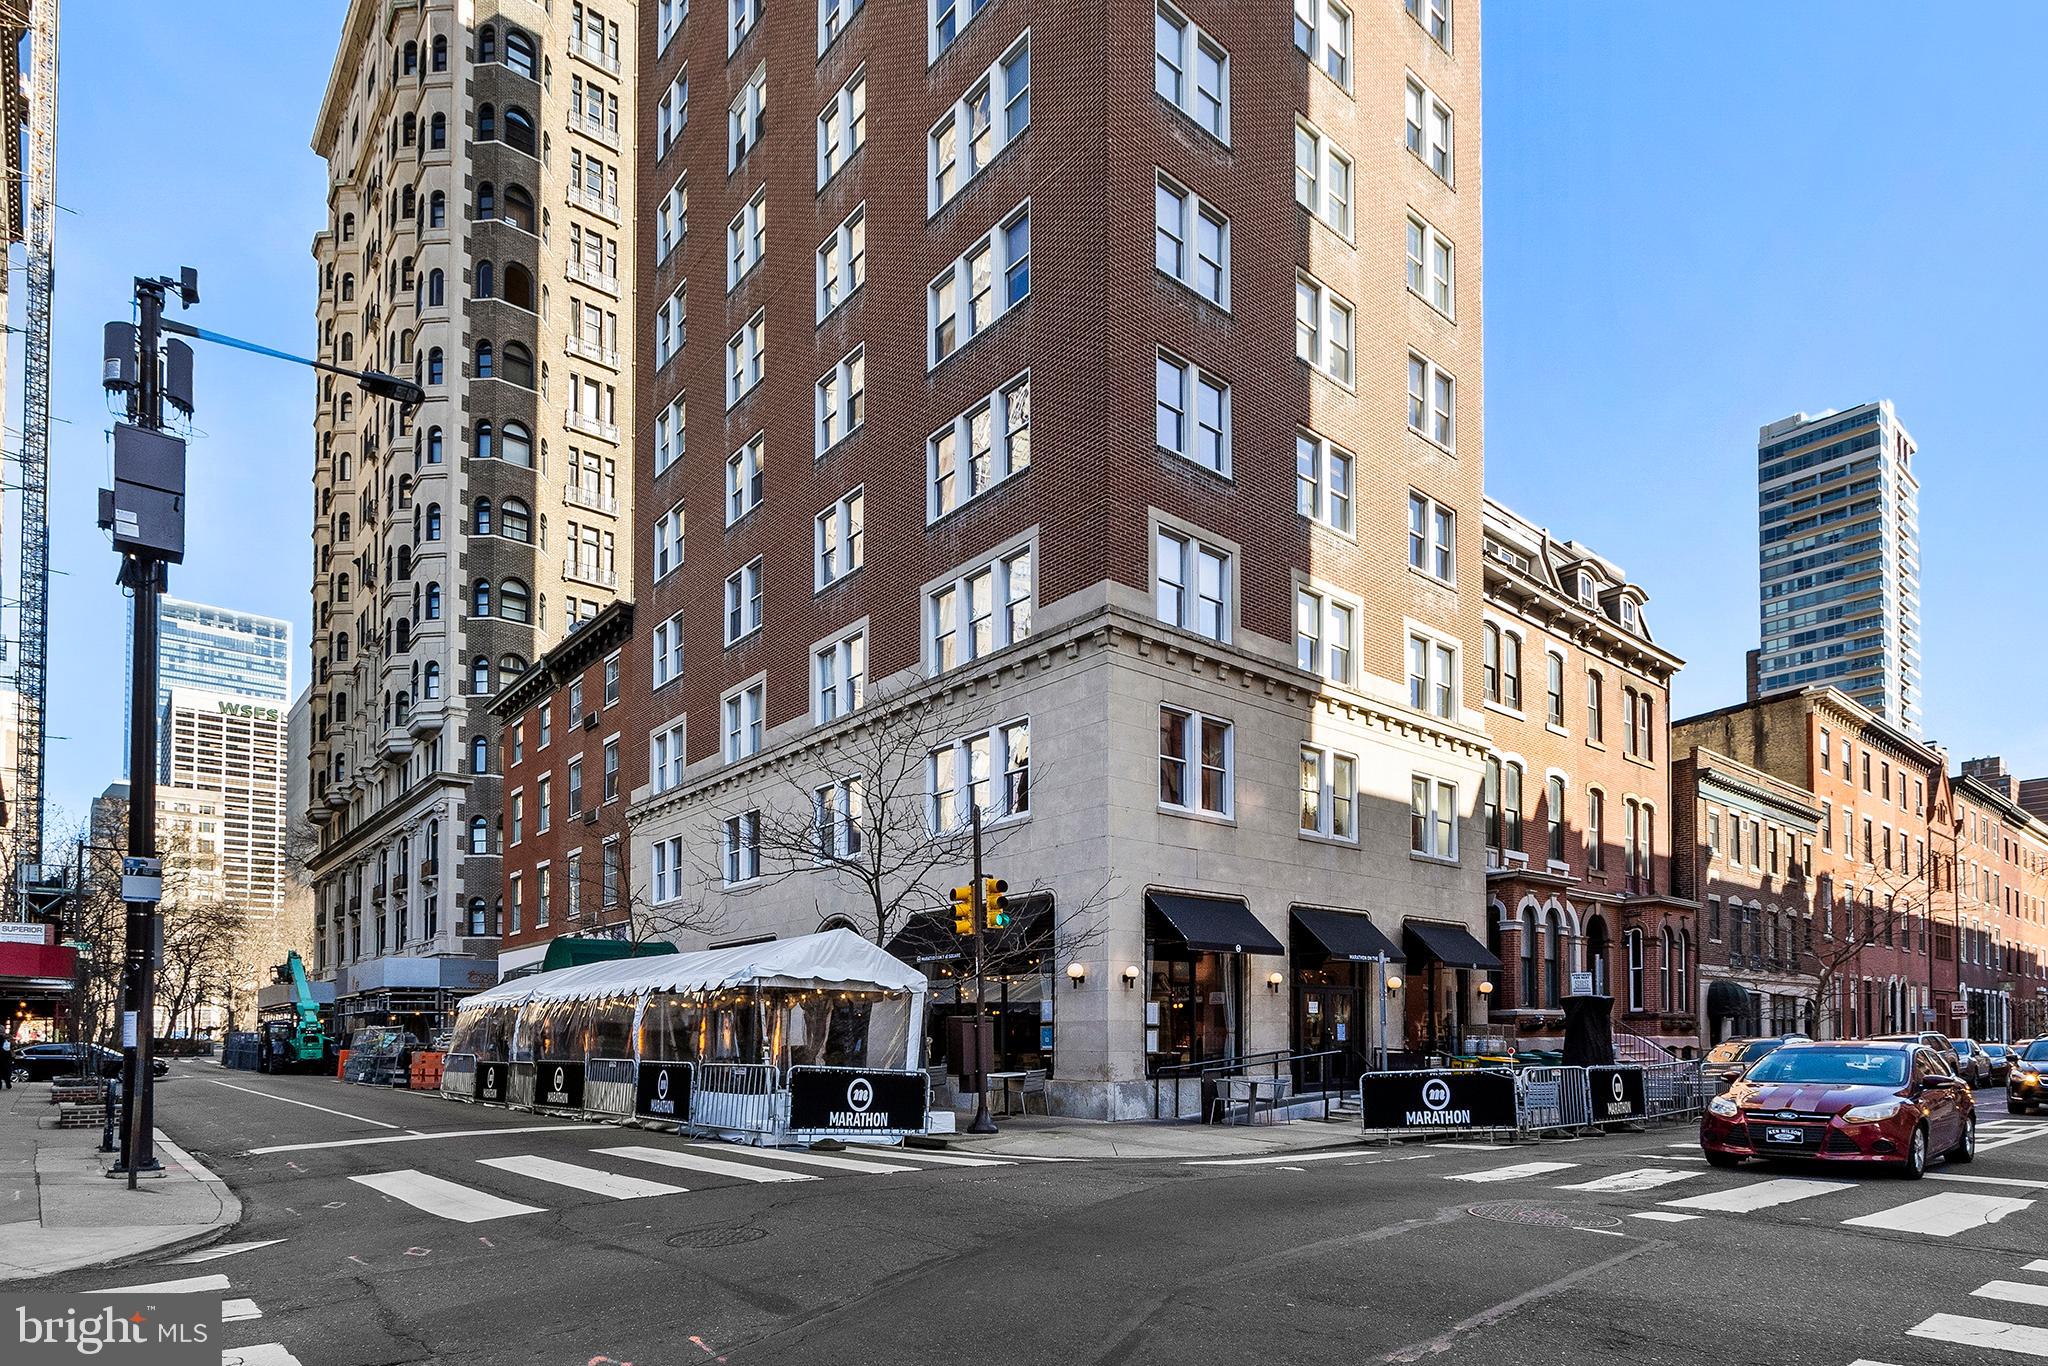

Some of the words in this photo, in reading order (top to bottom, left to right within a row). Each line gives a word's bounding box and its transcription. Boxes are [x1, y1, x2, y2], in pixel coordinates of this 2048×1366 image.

[218, 701, 279, 720] WSFS
[2, 925, 43, 933] SUPERIOR
[547, 1092, 568, 1103] MARATHON
[651, 1099, 674, 1114] MARATHON
[1607, 1101, 1631, 1115] MARATHON
[830, 1112, 888, 1127] MARATHON
[1406, 1110, 1470, 1125] MARATHON
